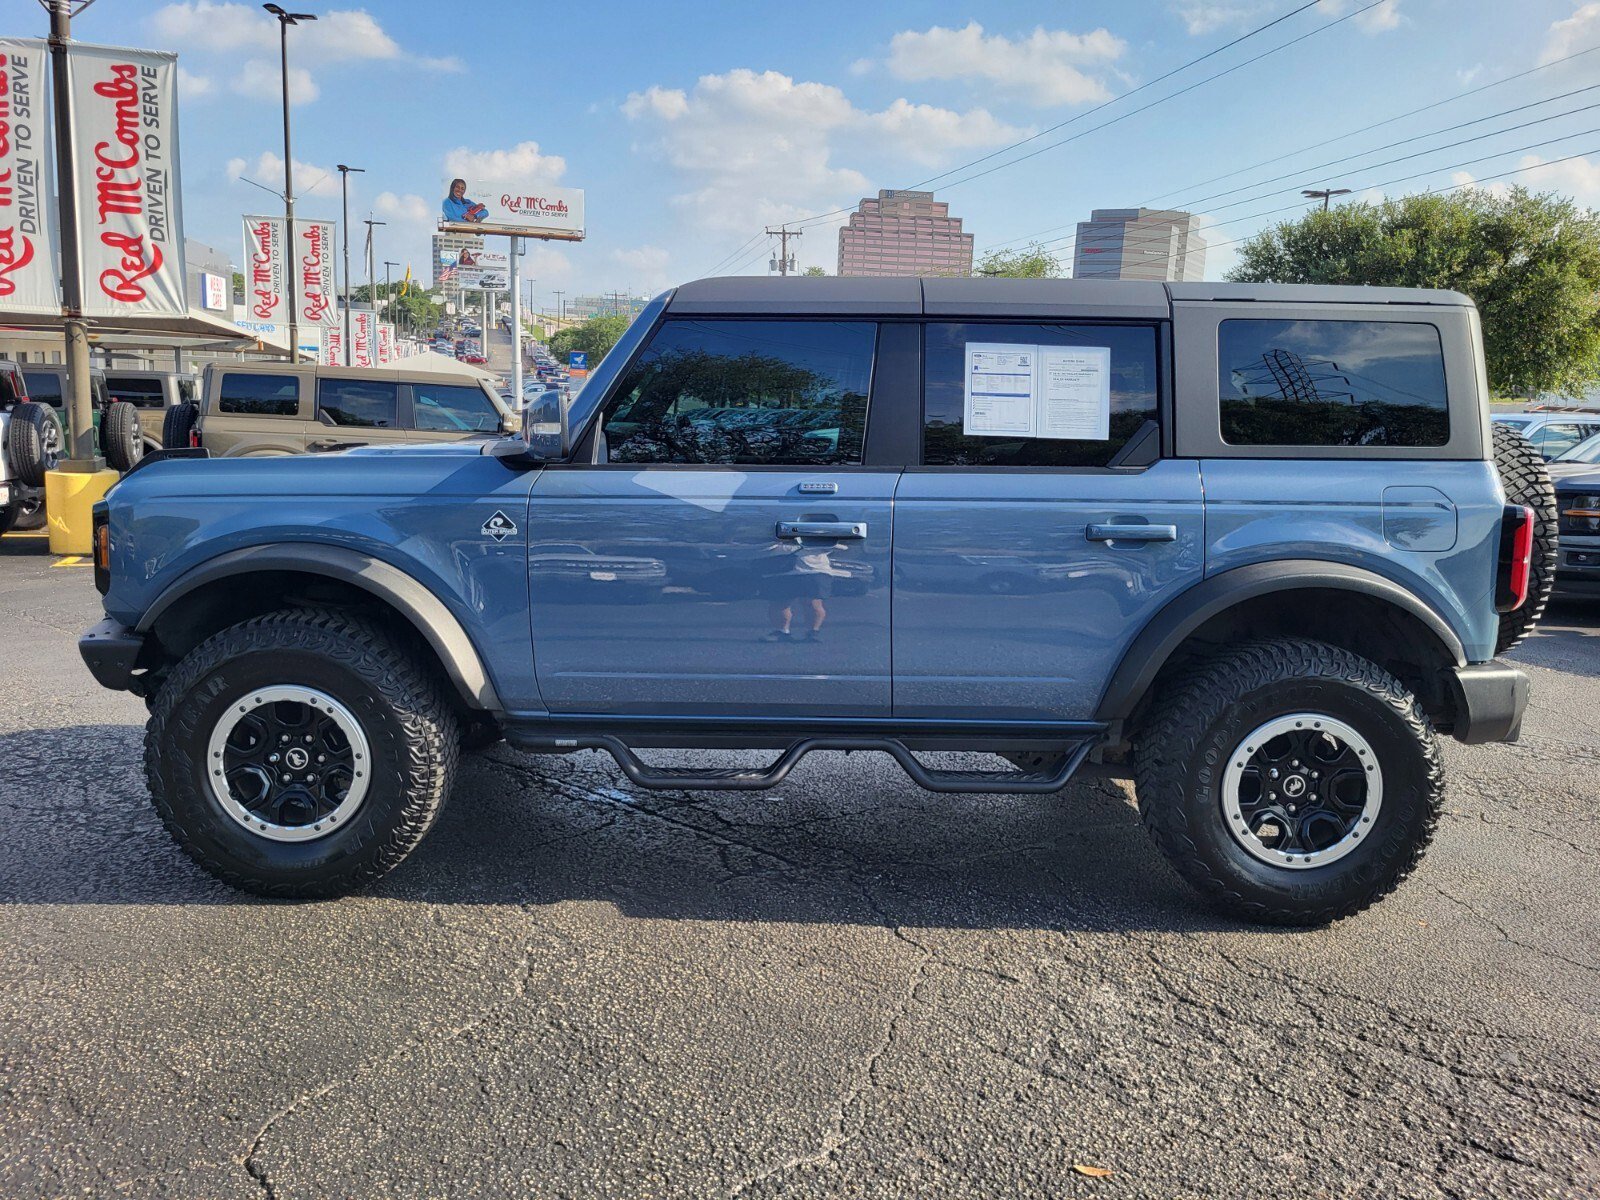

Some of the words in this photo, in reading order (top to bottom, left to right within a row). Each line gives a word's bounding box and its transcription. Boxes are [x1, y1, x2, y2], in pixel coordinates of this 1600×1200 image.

[11, 54, 30, 119] SERVE
[141, 65, 160, 130] SERVE
[15, 123, 32, 152] TO
[93, 64, 142, 225] McCombs
[144, 133, 162, 161] TO
[16, 158, 36, 235] DRIVEN
[146, 168, 165, 243] DRIVEN
[501, 194, 521, 213] Red
[523, 196, 568, 213] McCombs
[271, 222, 279, 248] SERVE
[100, 231, 163, 302] Red
[252, 222, 271, 286] McCombs
[272, 250, 279, 260] TO
[303, 225, 321, 289] McCombs
[322, 252, 329, 263] TO
[272, 263, 280, 294] DRIVEN
[322, 266, 330, 296] DRIVEN
[253, 289, 279, 319] Red
[303, 292, 329, 321] Red
